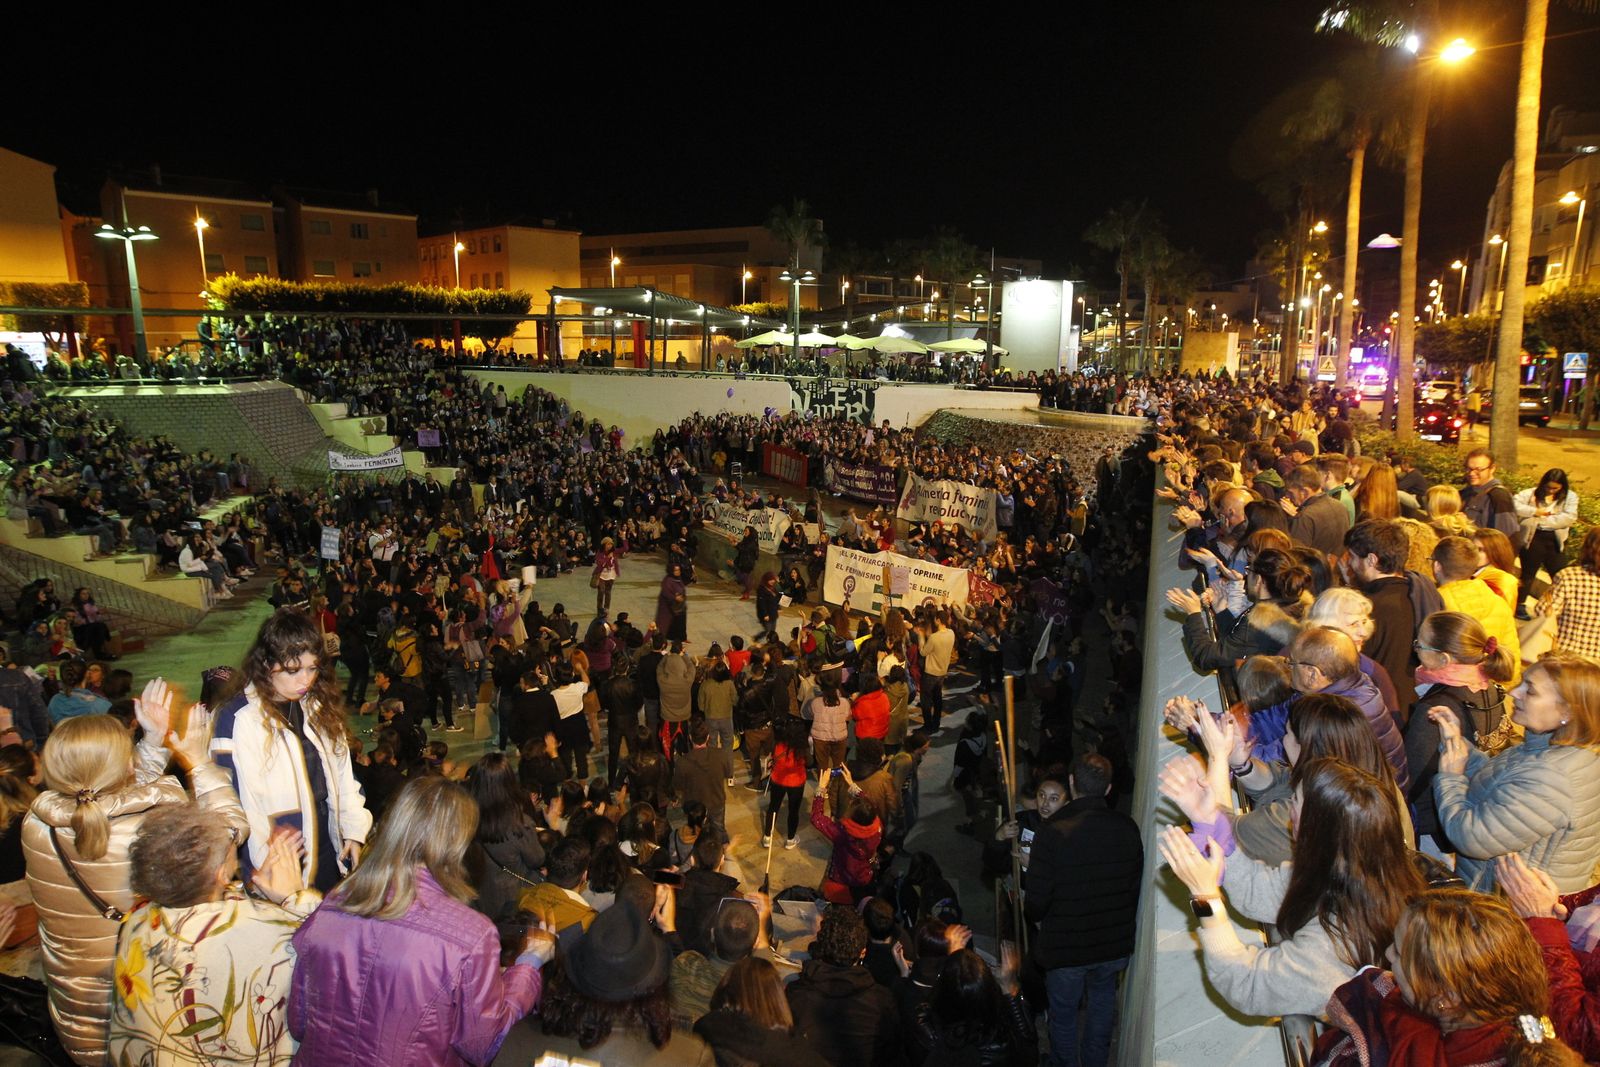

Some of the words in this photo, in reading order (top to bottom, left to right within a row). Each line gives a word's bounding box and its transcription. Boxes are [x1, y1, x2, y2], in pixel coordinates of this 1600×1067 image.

[835, 562, 844, 571] EL
[845, 565, 881, 582] FEMINISMO
[919, 585, 950, 599] LIBRES!
